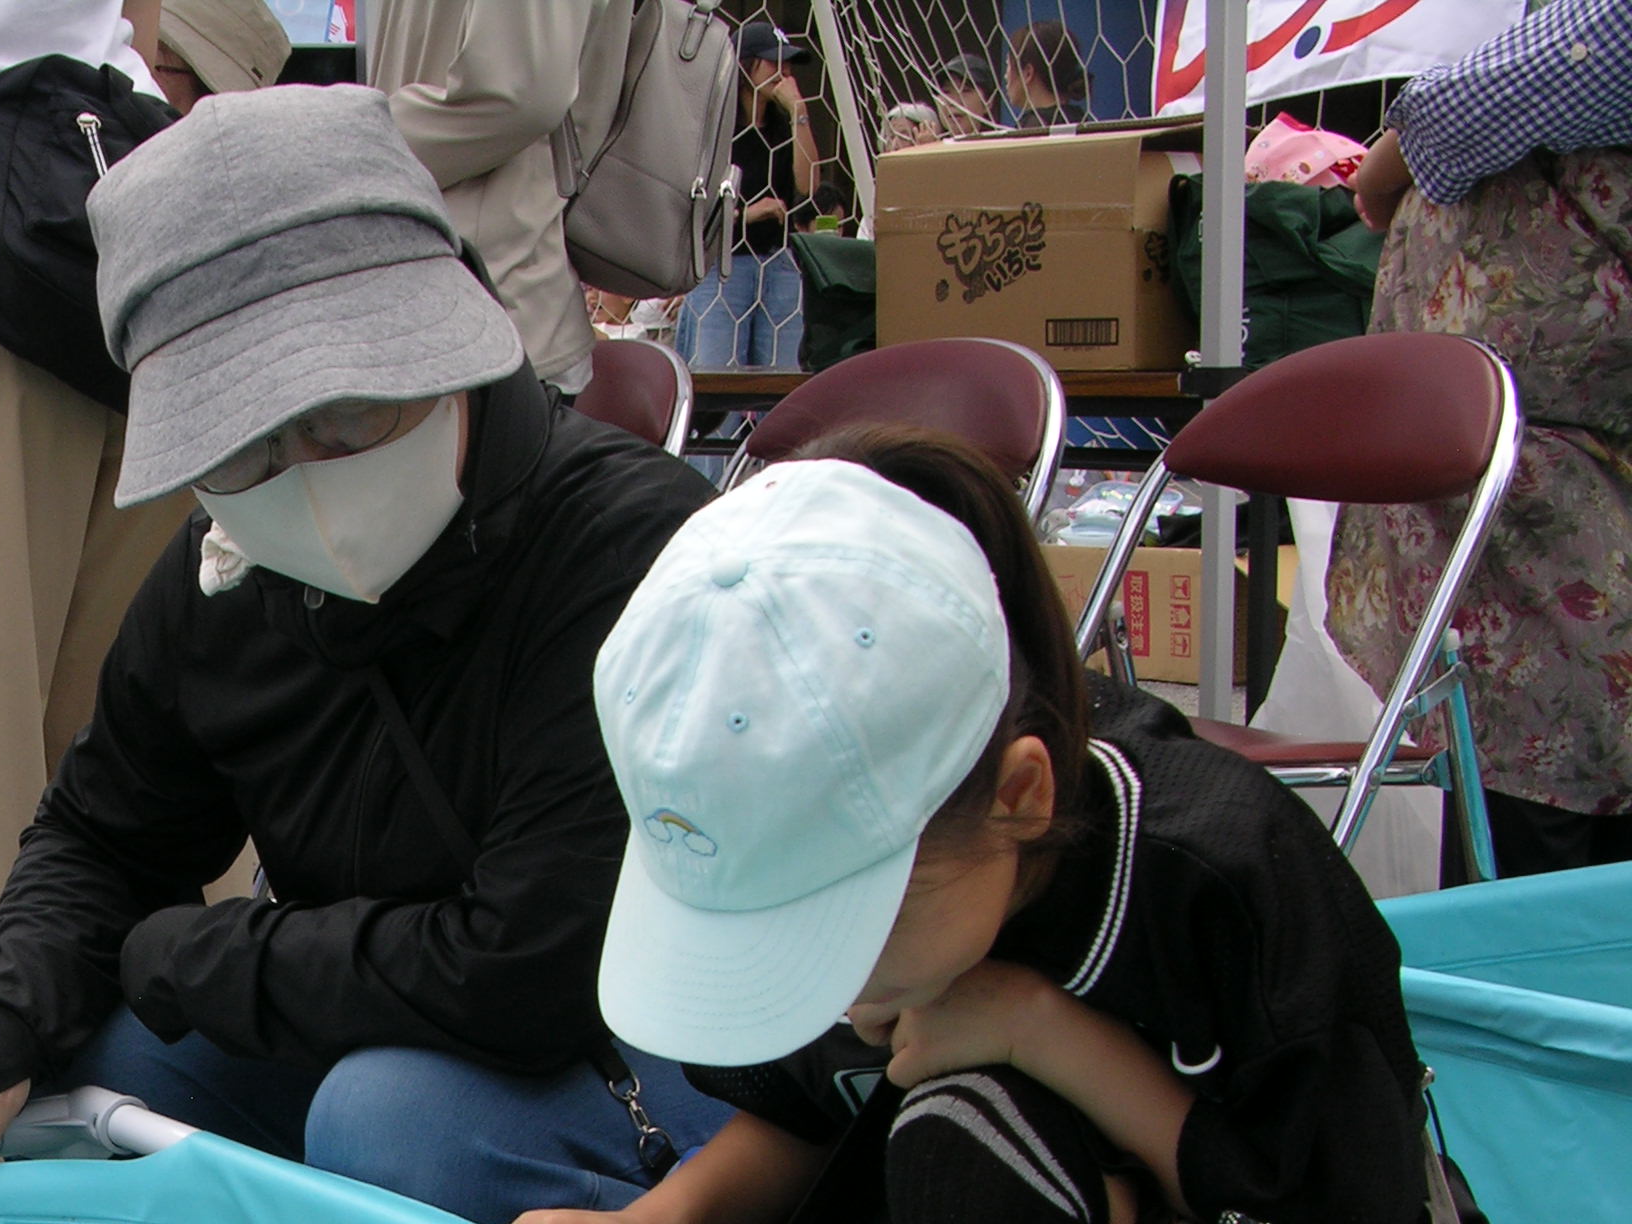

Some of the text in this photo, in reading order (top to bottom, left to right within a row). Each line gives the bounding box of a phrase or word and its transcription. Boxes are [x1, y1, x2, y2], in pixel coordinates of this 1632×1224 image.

[938, 202, 1046, 280] もちっと
[984, 241, 1046, 292] いちご
